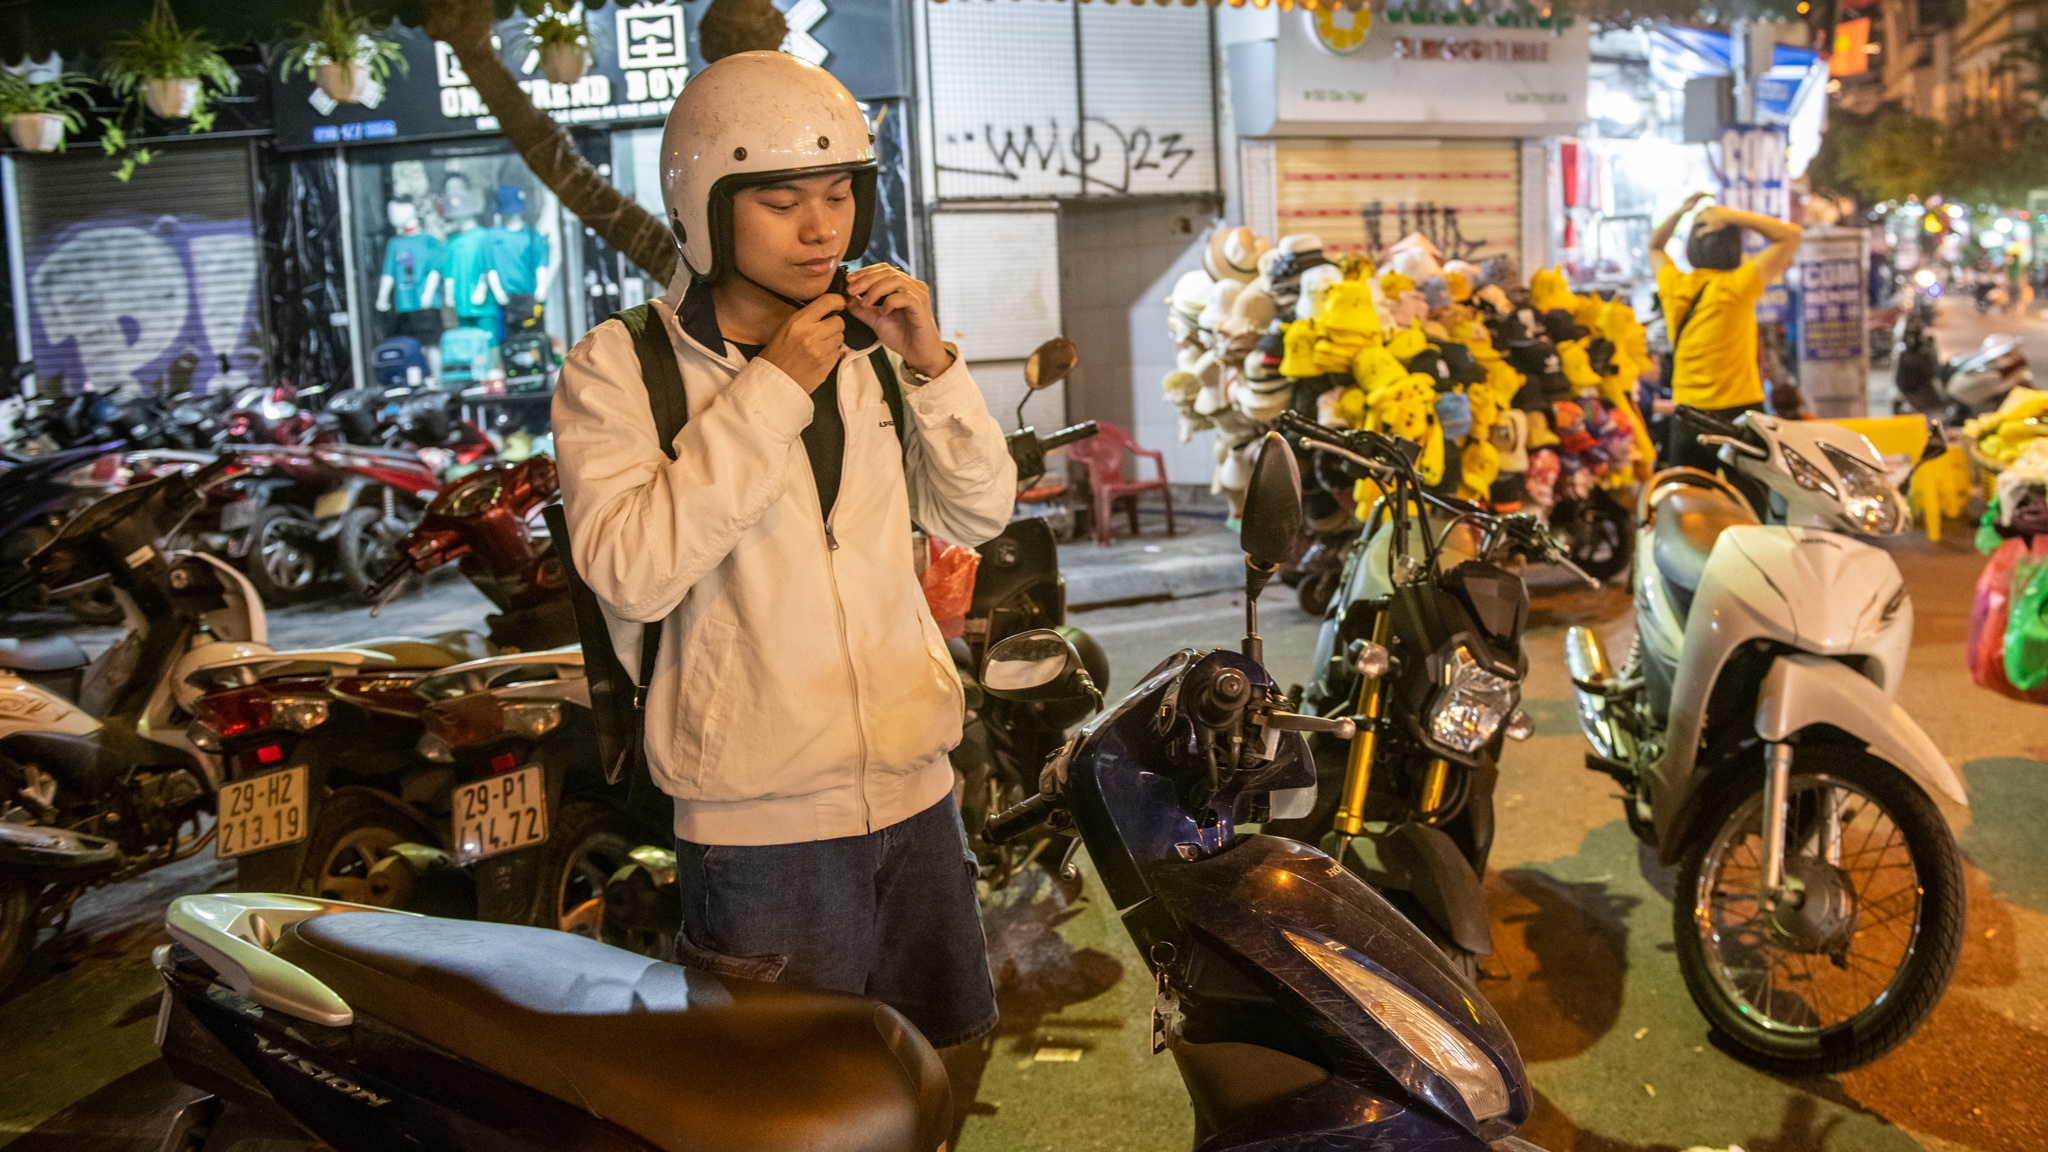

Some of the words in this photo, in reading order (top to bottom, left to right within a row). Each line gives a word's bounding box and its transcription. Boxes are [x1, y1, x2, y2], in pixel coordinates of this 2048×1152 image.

[625, 67, 690, 102] BOY
[230, 773, 294, 818] 29-H2
[463, 774, 528, 821] 29-P1
[221, 806, 300, 854] 213.19
[1324, 864, 1342, 878] HO
[254, 1032, 392, 1107] VISION
